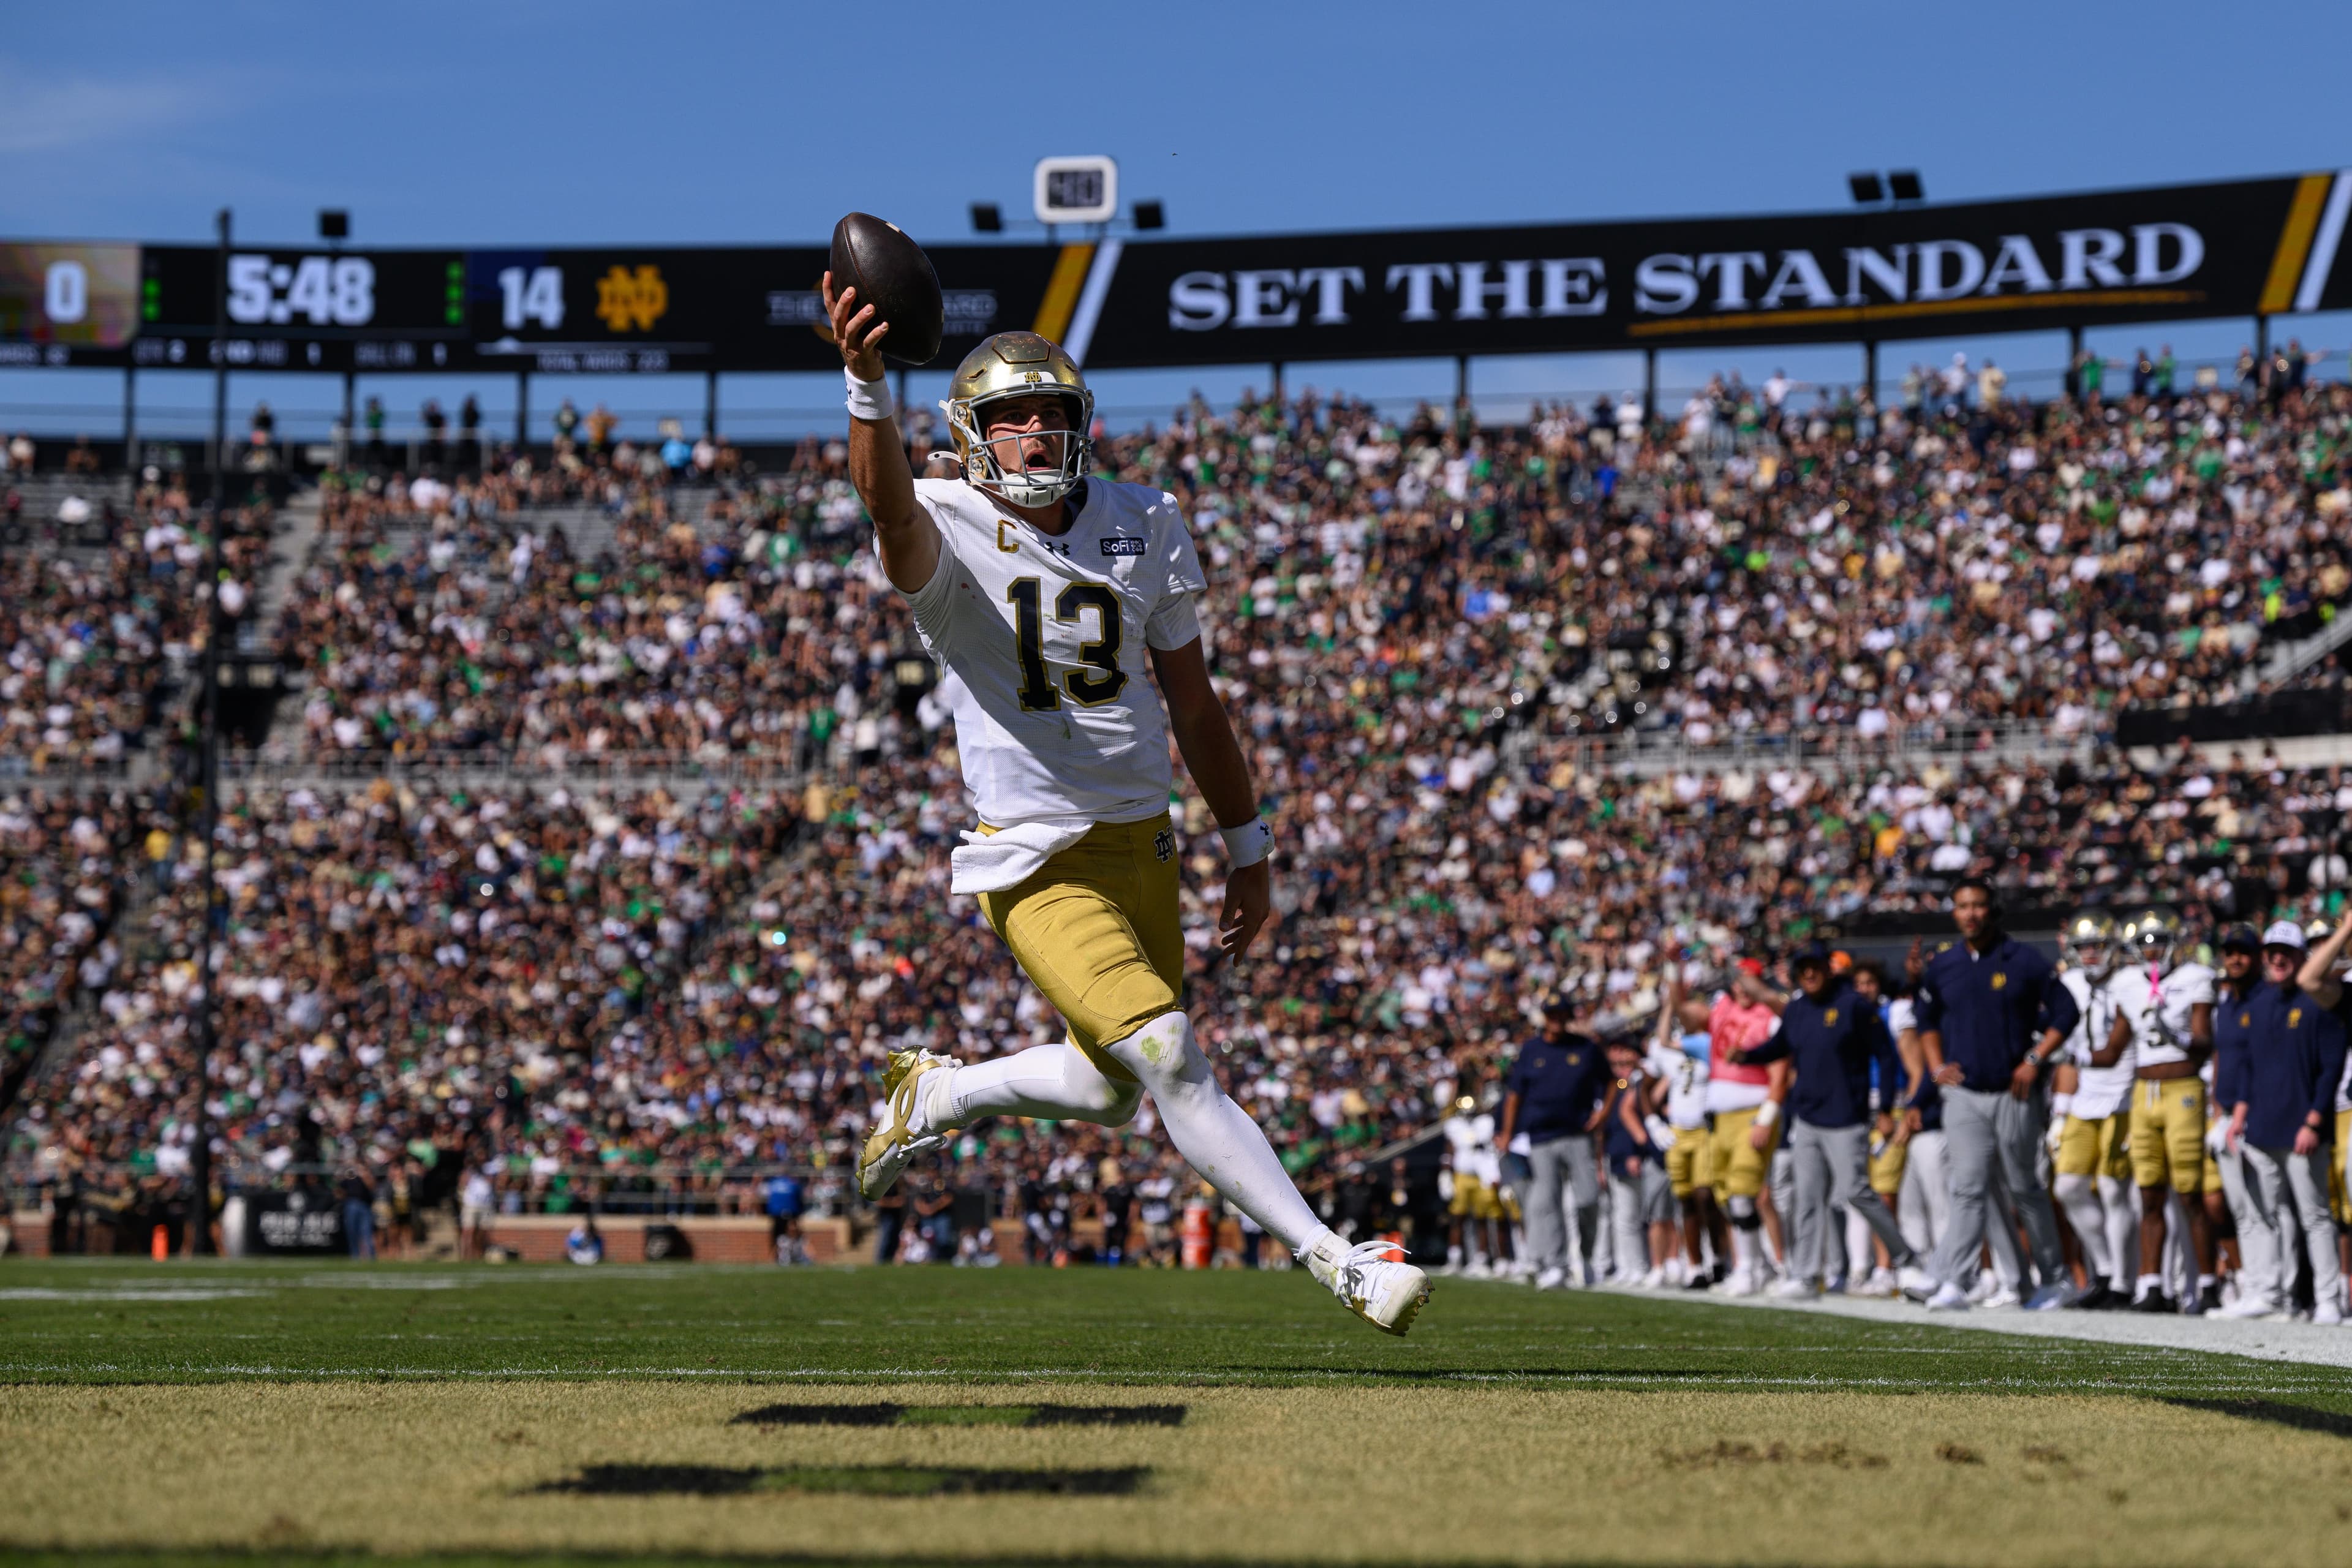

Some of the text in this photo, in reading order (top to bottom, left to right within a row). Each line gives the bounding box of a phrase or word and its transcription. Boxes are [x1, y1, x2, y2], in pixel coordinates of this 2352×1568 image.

[44, 260, 88, 325] 0
[226, 254, 376, 326] 5:48
[499, 266, 565, 330] 14
[1168, 223, 2206, 332] SET THE STANDARD
[997, 519, 1019, 554] C
[1102, 540, 1129, 554] SoFi
[1007, 576, 1129, 712] 13
